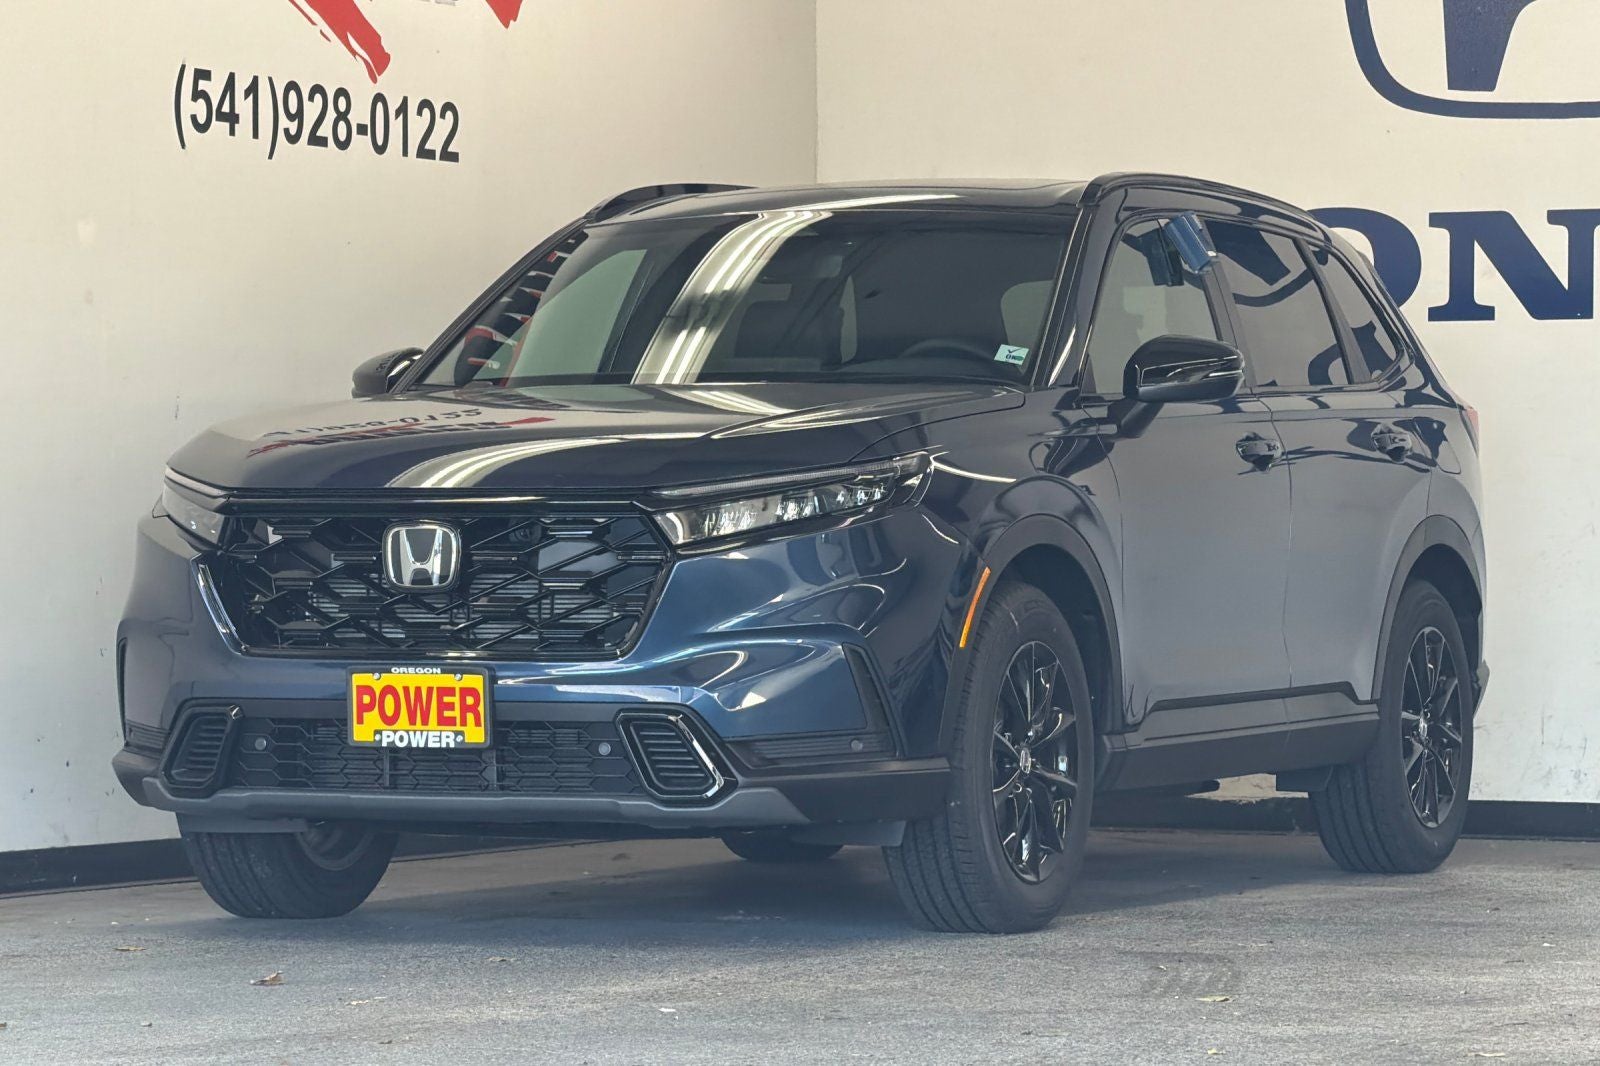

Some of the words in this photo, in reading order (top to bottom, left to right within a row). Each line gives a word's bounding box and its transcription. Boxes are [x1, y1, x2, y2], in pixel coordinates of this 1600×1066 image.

[173, 61, 461, 163] (541)928-0122
[356, 684, 482, 727] POWER
[381, 730, 455, 748] POWER
